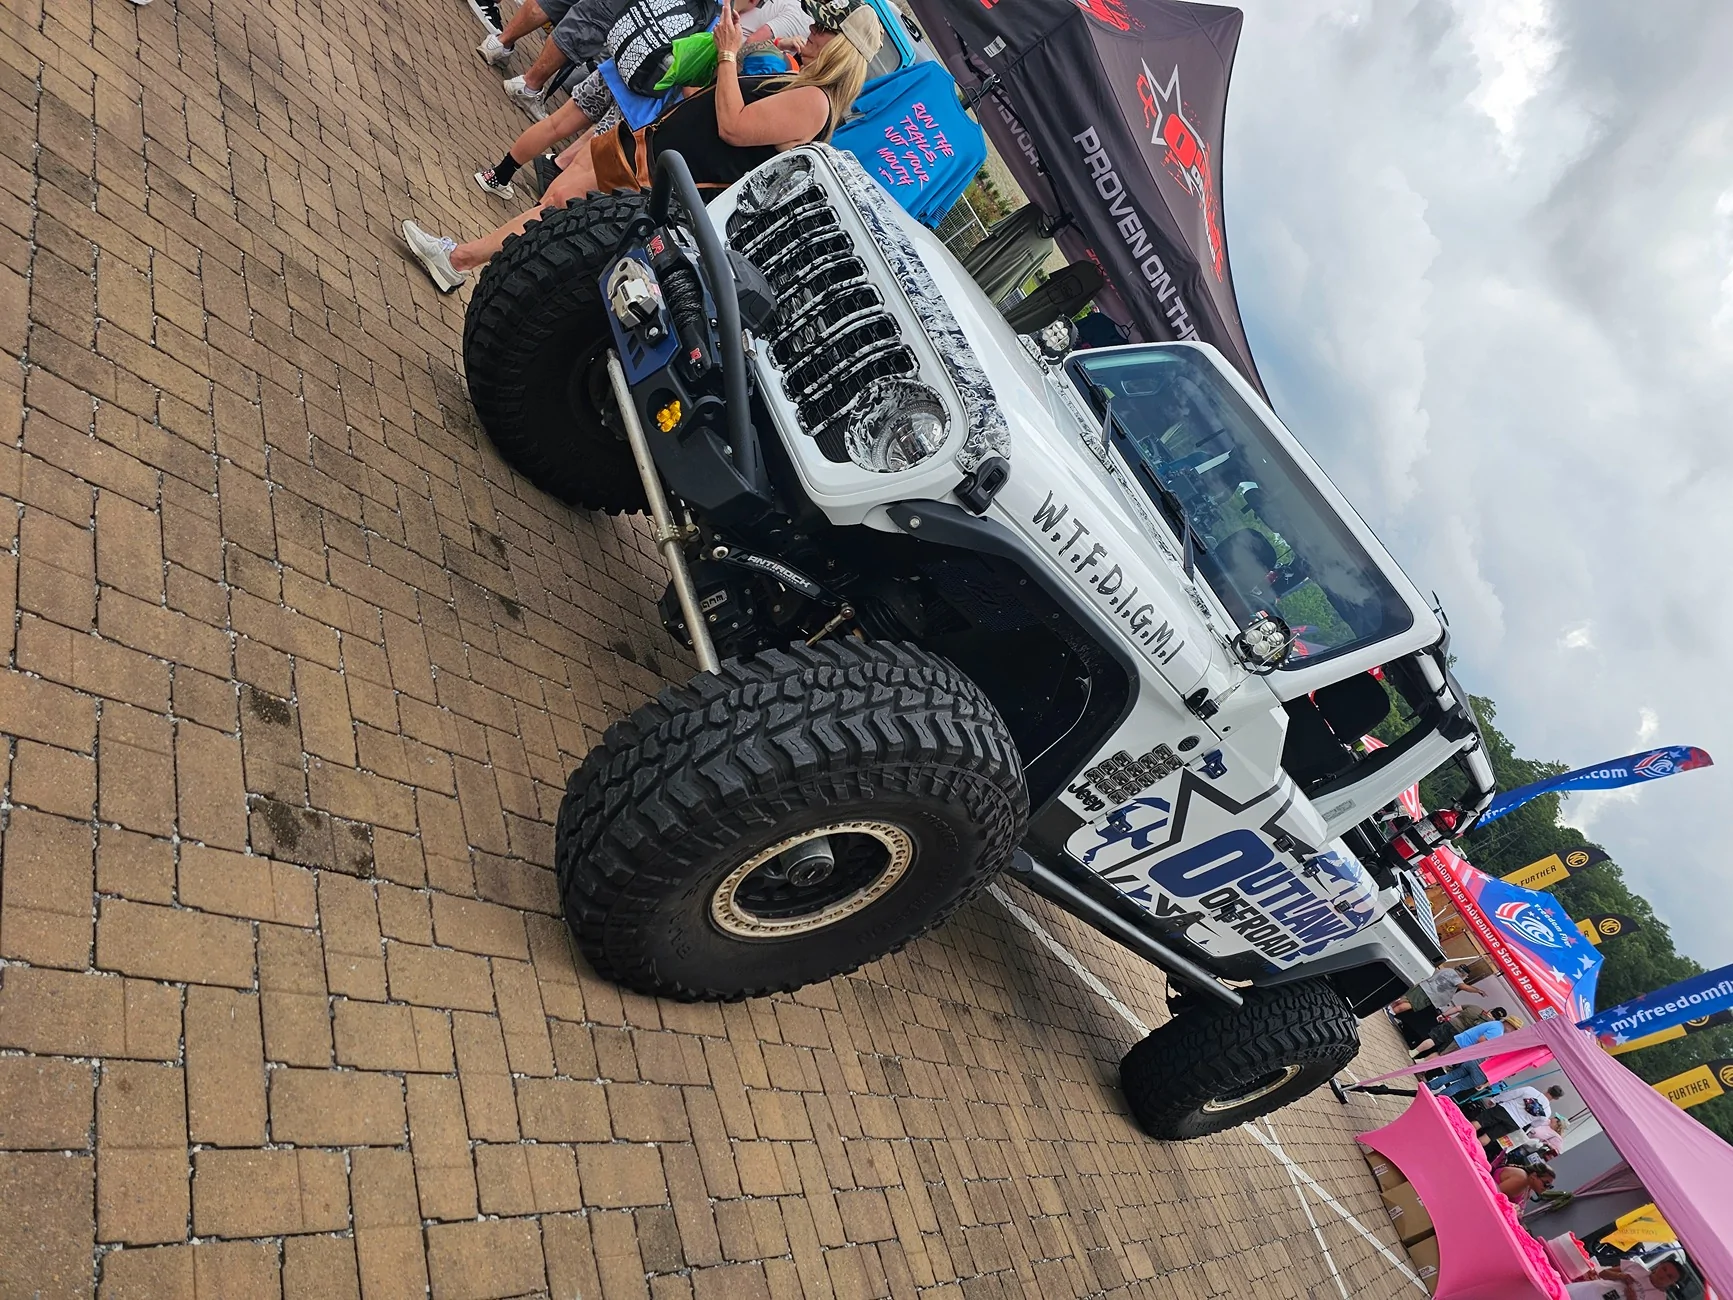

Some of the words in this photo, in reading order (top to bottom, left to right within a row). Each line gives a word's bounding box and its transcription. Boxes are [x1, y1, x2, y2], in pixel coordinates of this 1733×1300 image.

[912, 102, 939, 129] RUN
[933, 130, 955, 158] THE
[876, 147, 914, 186] MOUTH
[884, 126, 909, 147] NOT
[901, 150, 930, 191] YOUR
[1072, 125, 1154, 259] PROVEN
[1140, 254, 1177, 303] ON
[747, 554, 813, 589] ANTIROCK
[1067, 781, 1106, 812] Jeep
[1148, 828, 1350, 944] OUTLAW
[1520, 864, 1557, 887] FURTHER
[1430, 853, 1452, 884] eedom
[1449, 880, 1468, 904] Flyer
[1464, 902, 1501, 948] Adventure
[1497, 947, 1522, 976] Starts
[1517, 973, 1545, 1004] Here!
[1534, 903, 1563, 933] Freedom
[1610, 980, 1733, 1033] myfreedomfl
[1667, 1078, 1711, 1102] FURTHER
